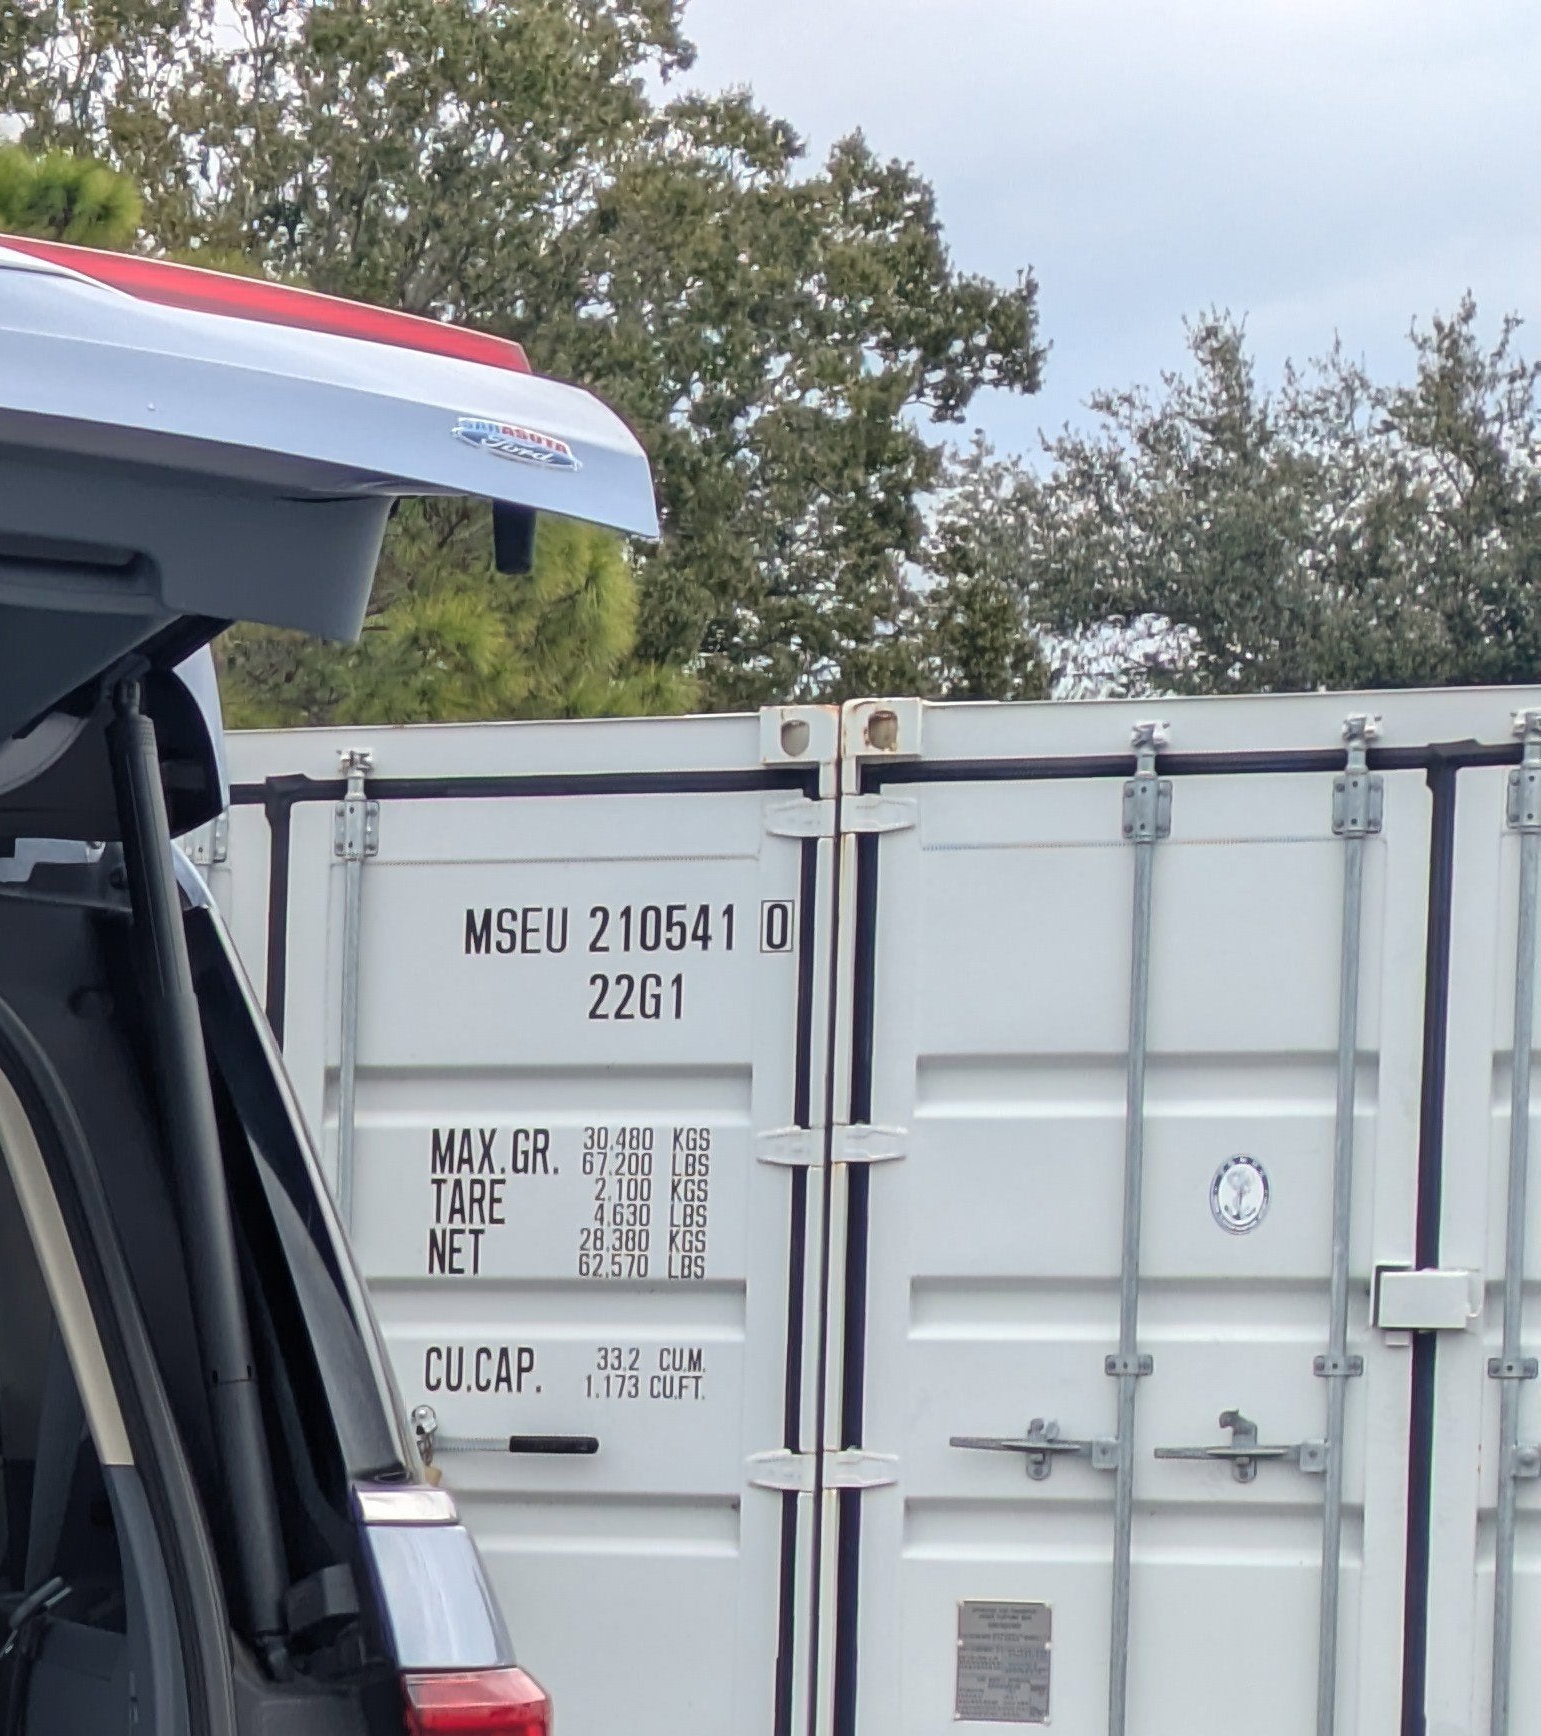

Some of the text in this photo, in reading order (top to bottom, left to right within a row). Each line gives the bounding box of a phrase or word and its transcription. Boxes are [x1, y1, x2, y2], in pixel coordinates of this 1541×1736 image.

[481, 437, 555, 461] Ford
[465, 906, 568, 955] MSEU
[588, 903, 735, 952] 210541
[588, 973, 683, 1020] 22G1
[583, 1126, 711, 1151] 30.480 KGS
[582, 1151, 710, 1177] 67.200 LBS
[431, 1178, 507, 1224] TARE
[594, 1177, 709, 1202] 2.100 KGS
[594, 1203, 708, 1228] 4.630 LBS
[428, 1228, 485, 1275] NET
[579, 1228, 706, 1253] 28.380 KGS
[578, 1253, 705, 1279] 62.570 LBS
[597, 1347, 640, 1371] 33.2
[586, 1374, 639, 1398] 1.173
